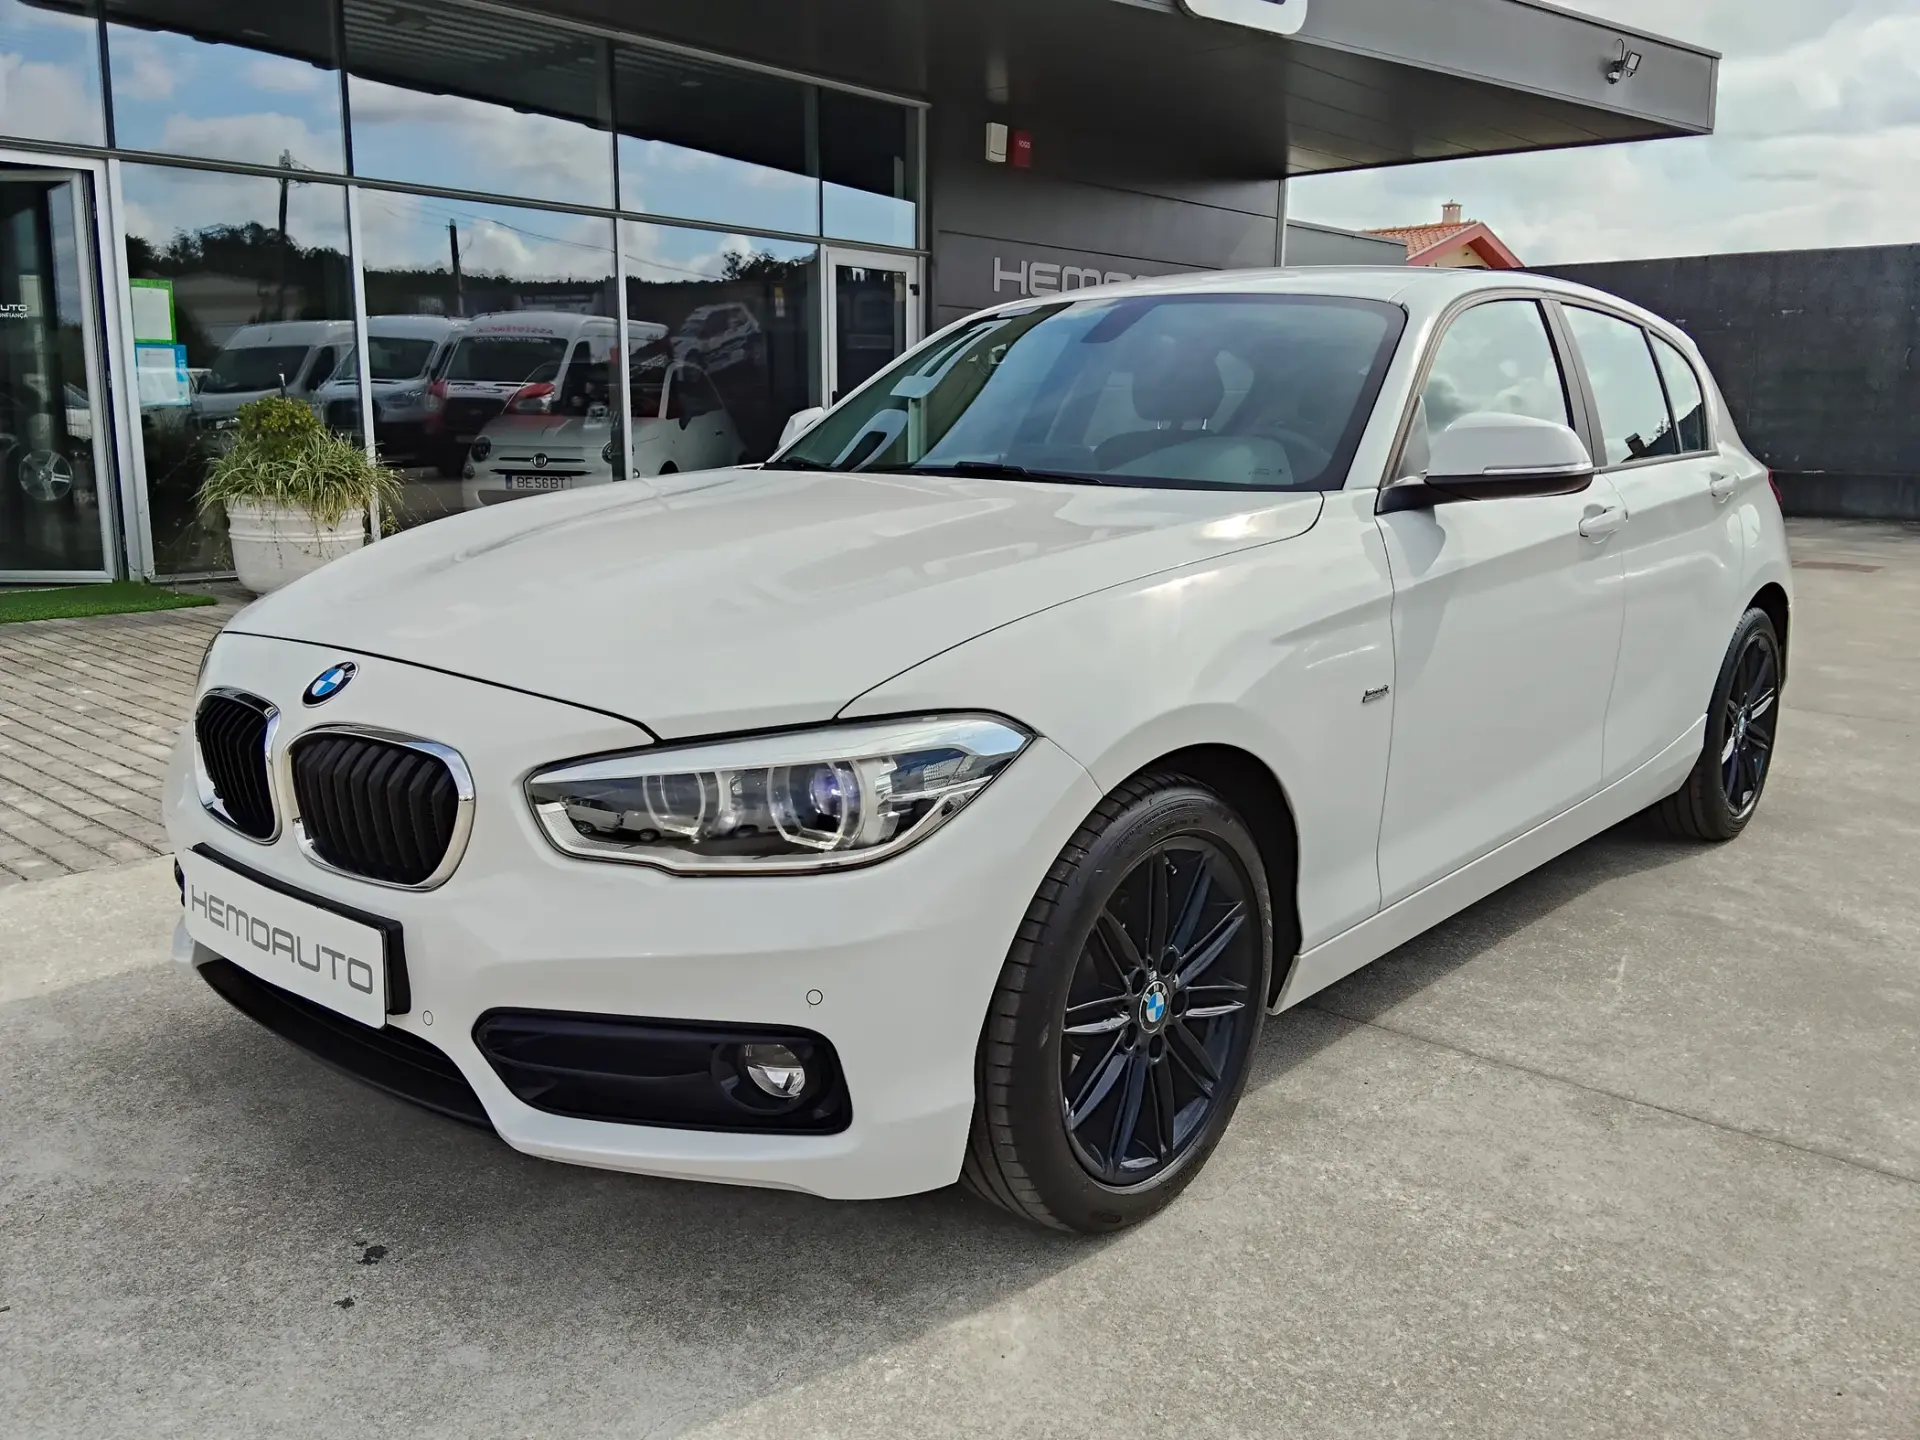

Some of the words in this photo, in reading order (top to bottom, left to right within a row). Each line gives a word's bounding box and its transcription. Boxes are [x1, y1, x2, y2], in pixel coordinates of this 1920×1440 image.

[993, 256, 1152, 297] HEM
[516, 476, 566, 489] BE56BT
[191, 884, 373, 995] HEMOAUTO
